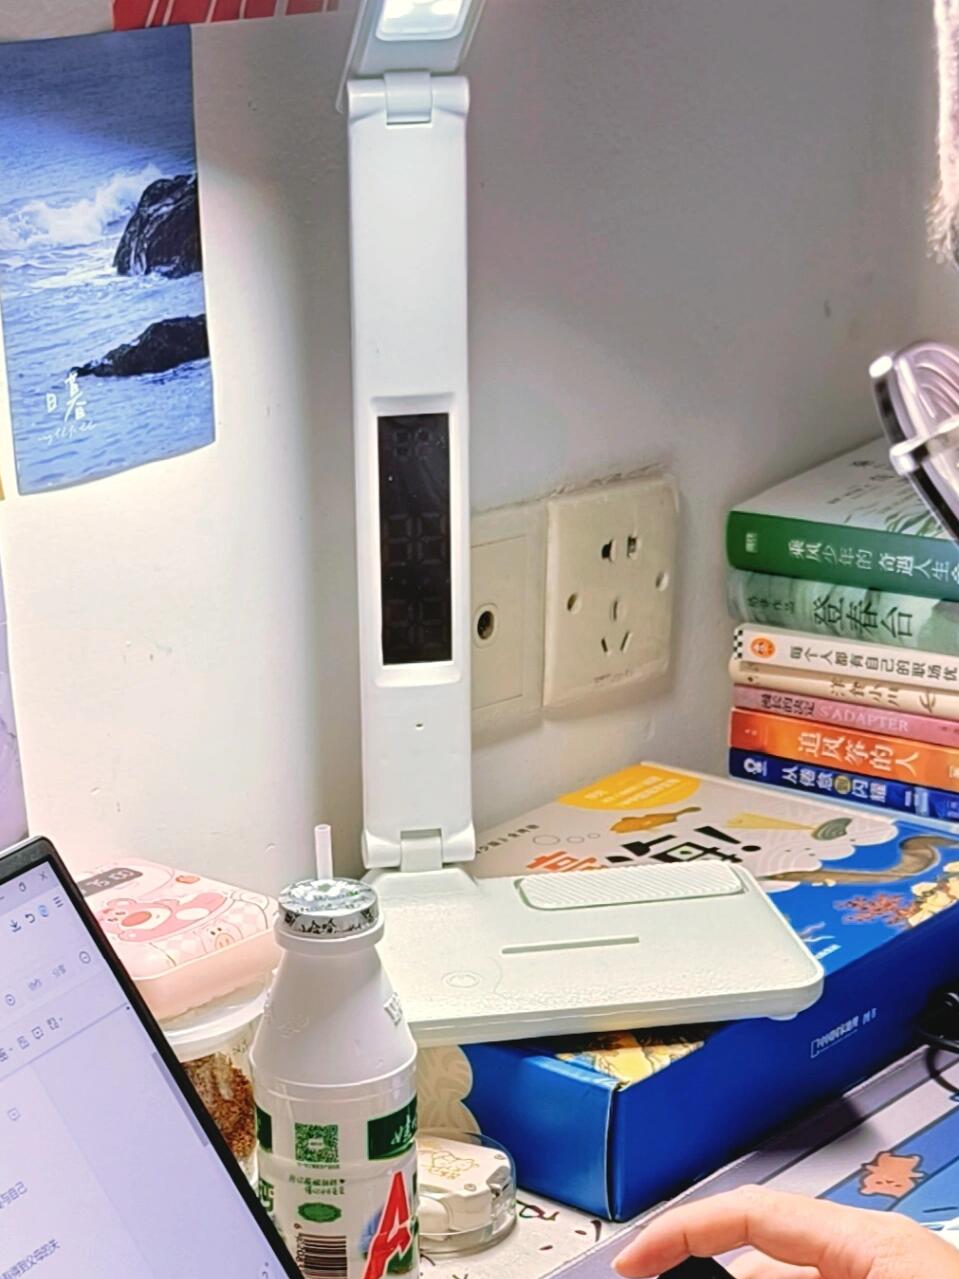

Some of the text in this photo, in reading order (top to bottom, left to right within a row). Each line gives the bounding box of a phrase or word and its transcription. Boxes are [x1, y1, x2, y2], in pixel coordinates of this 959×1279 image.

[813, 594, 914, 637] 登春台
[797, 730, 921, 778] 追风筝的人
